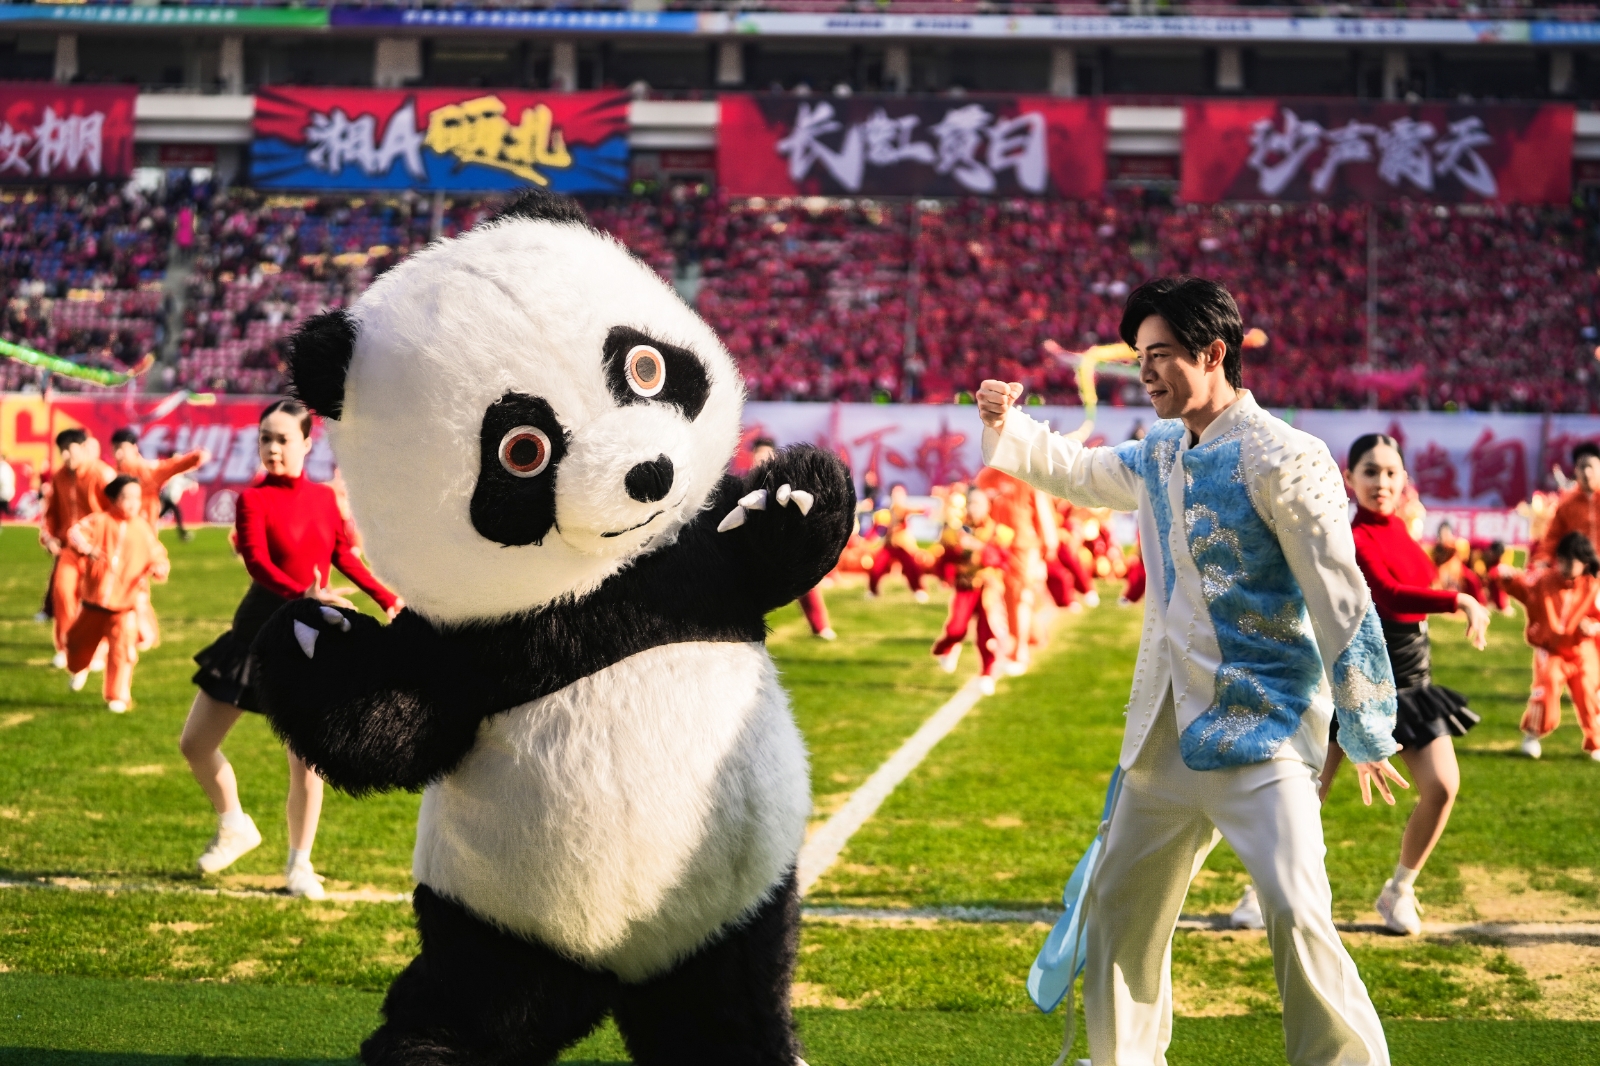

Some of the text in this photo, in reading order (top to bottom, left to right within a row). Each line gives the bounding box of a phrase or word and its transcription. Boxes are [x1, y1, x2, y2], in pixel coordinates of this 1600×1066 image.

[777, 100, 1049, 194] 长虹贯日
[1247, 107, 1498, 197] 沙声震天
